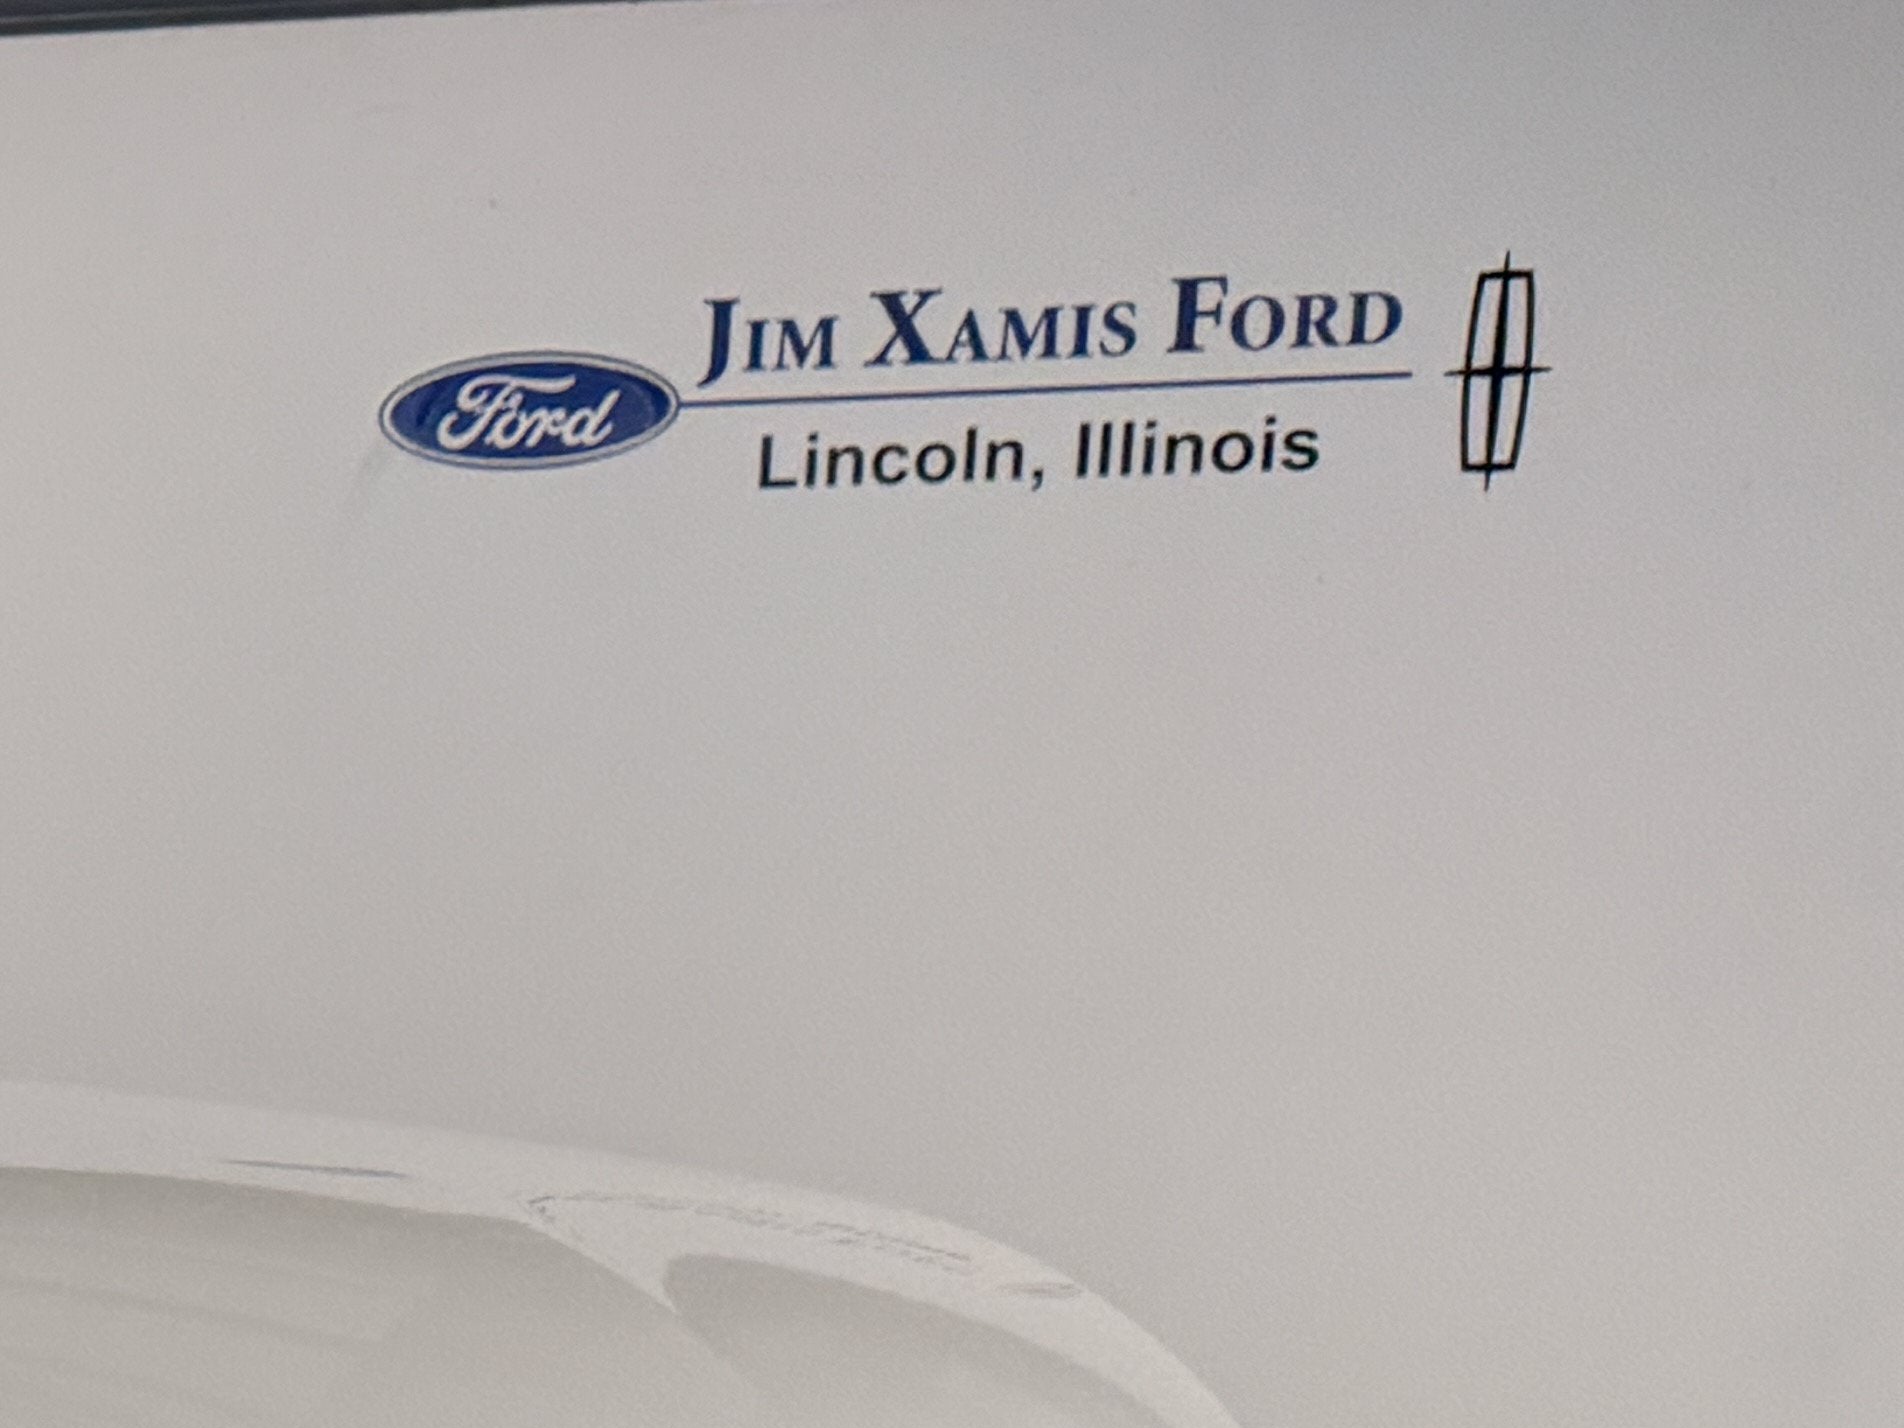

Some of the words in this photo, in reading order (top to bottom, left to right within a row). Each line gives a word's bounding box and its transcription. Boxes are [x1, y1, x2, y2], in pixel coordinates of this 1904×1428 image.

[436, 374, 620, 451] Ford
[758, 426, 1044, 492] Lincoln,
[1076, 416, 1319, 479] Illinois
